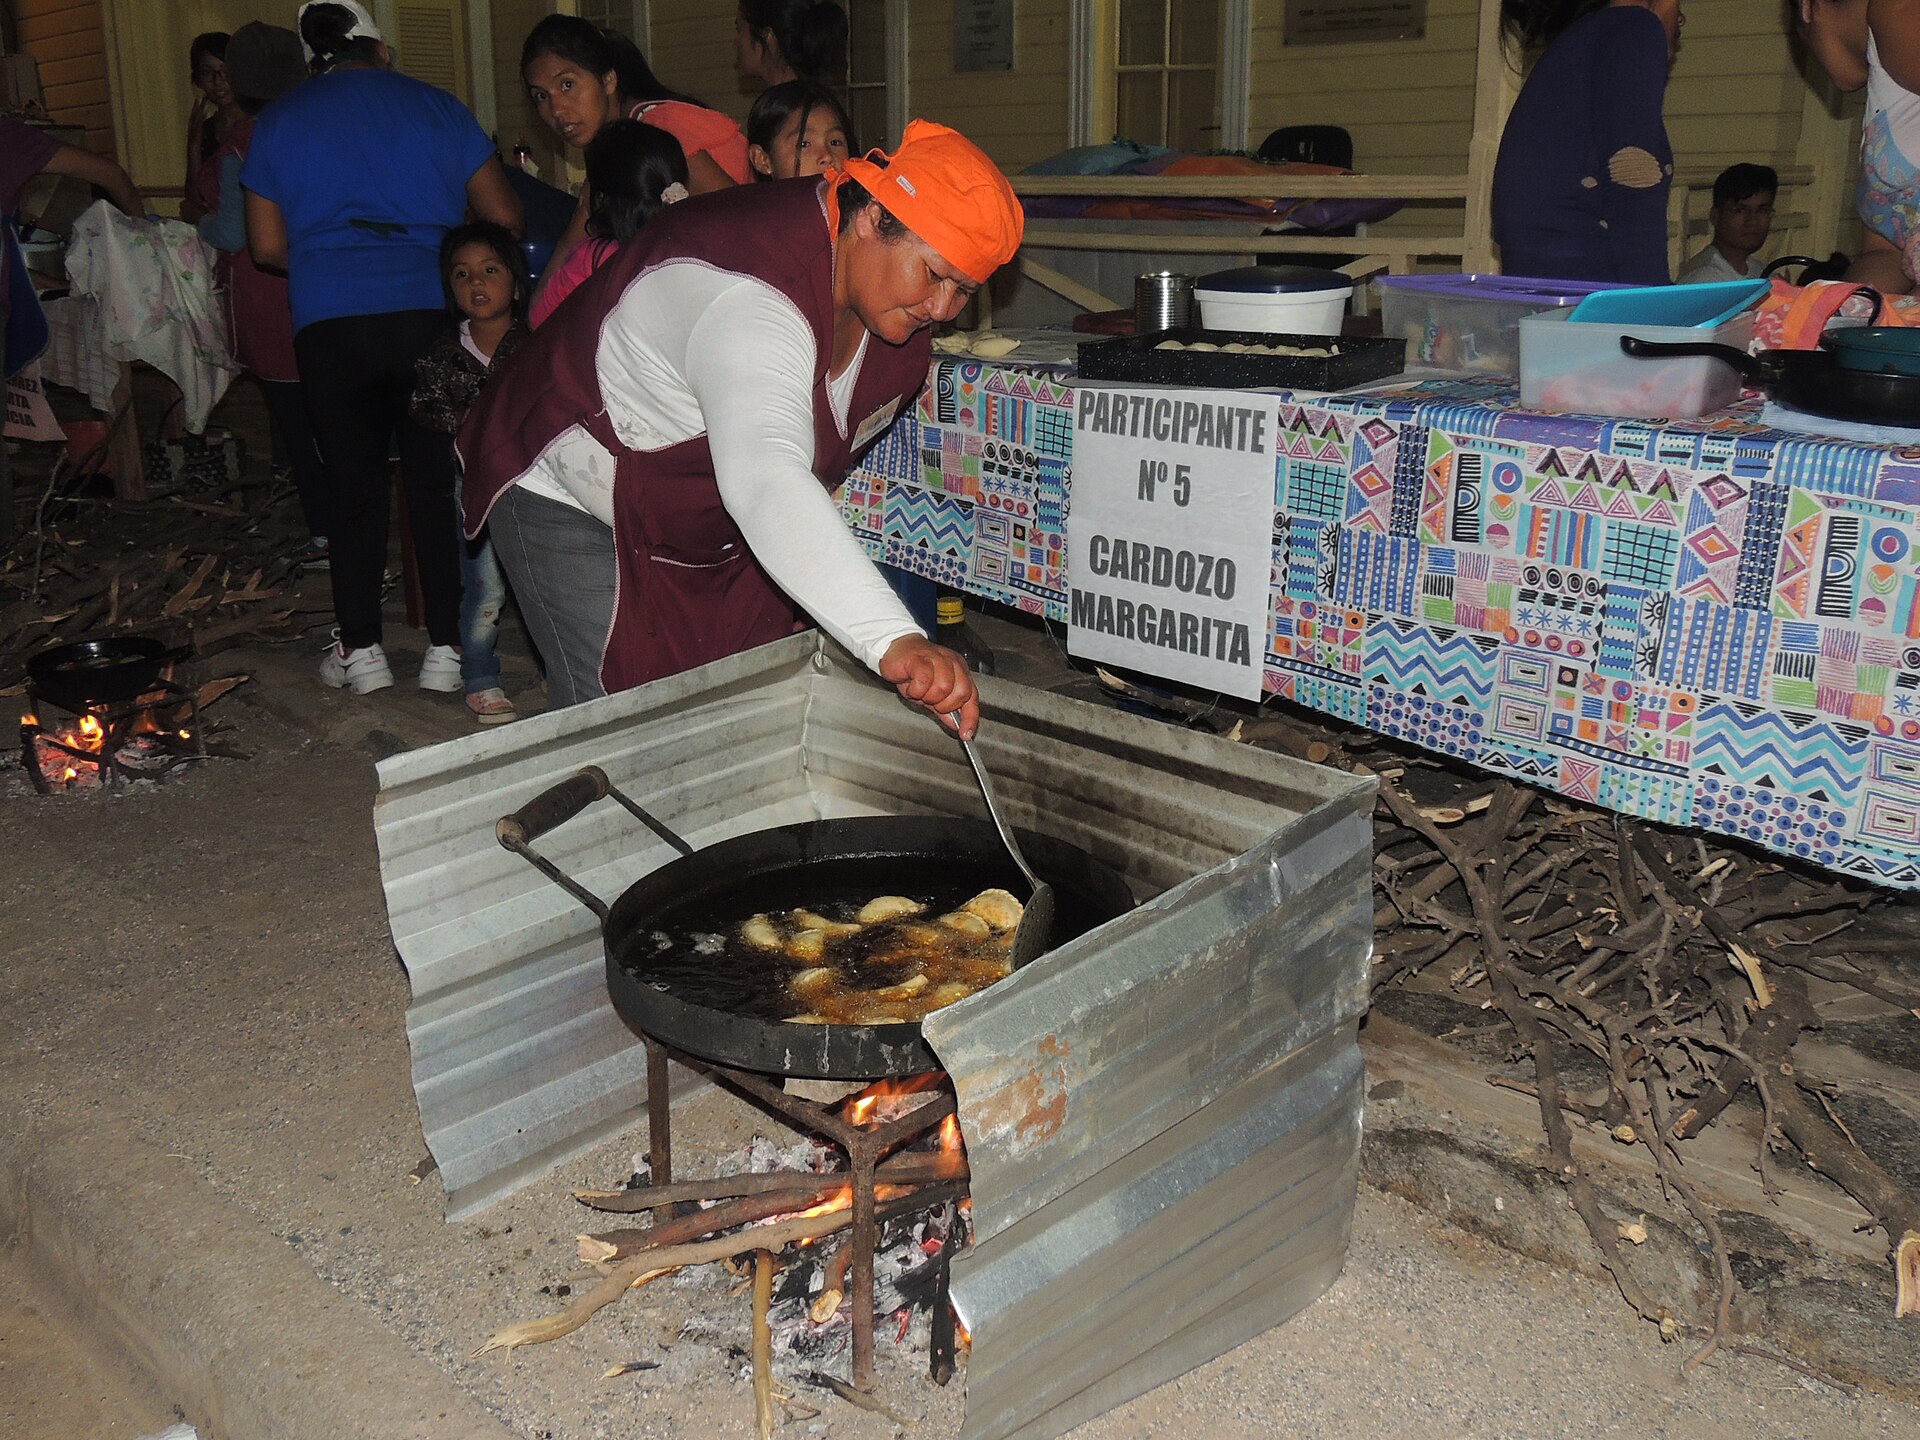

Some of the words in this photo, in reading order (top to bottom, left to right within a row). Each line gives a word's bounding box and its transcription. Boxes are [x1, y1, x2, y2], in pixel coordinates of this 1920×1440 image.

[1077, 390, 1267, 455] PARTICIPANTE
[1172, 464, 1192, 508] 5
[1089, 534, 1237, 601] CARDOZO
[1070, 587, 1252, 668] MARGARITA
